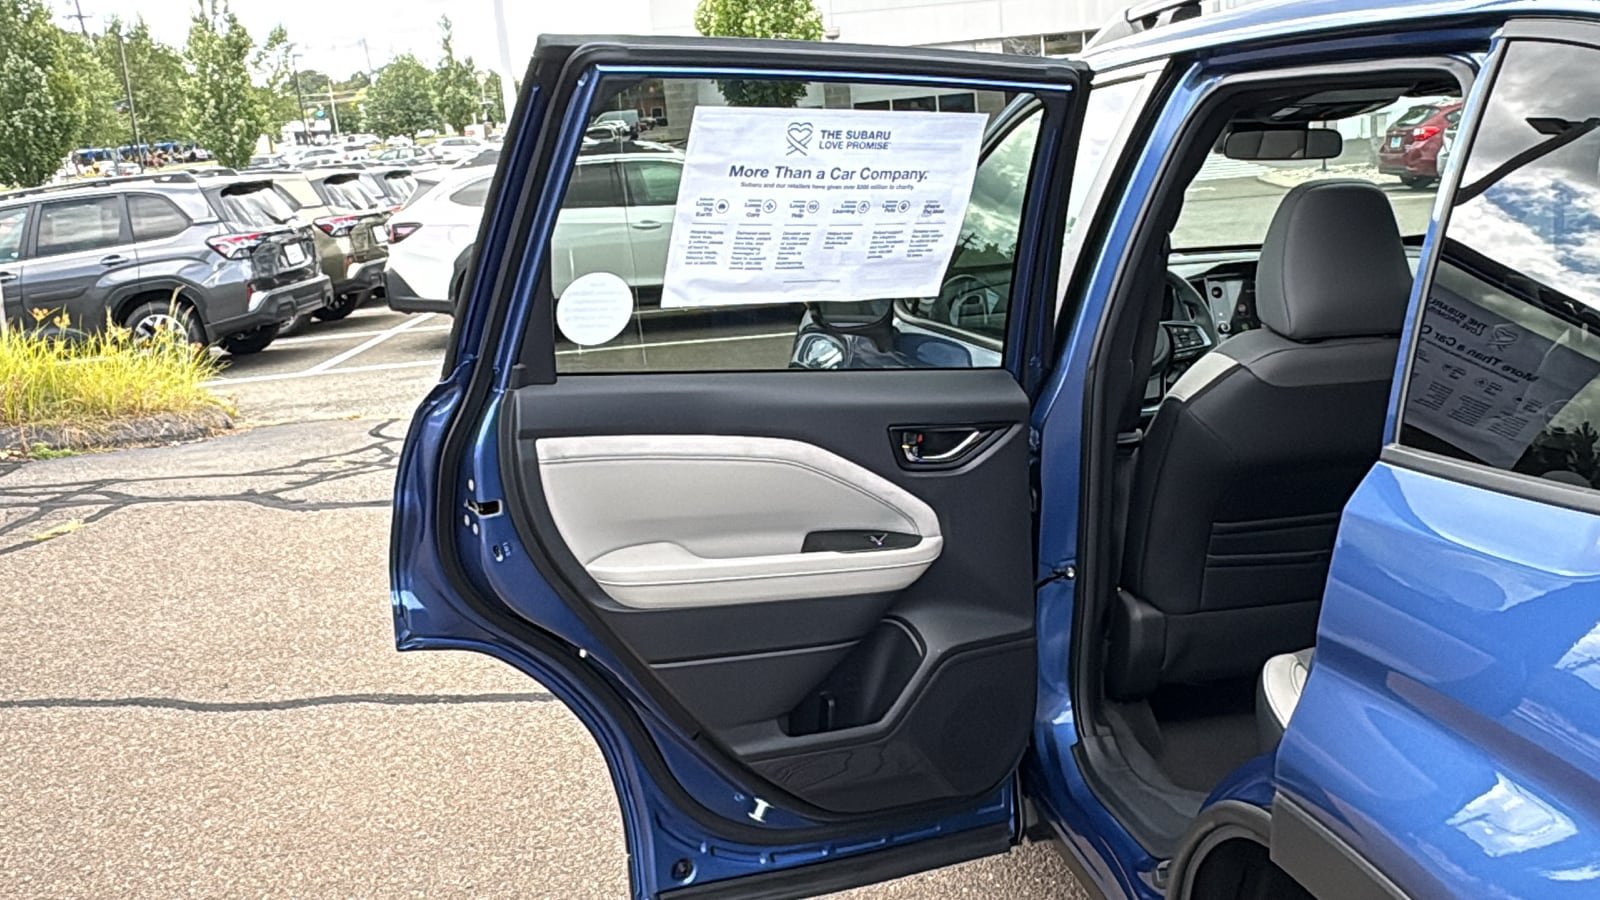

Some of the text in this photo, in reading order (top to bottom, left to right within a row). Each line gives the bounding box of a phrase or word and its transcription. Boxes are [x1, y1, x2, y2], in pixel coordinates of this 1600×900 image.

[820, 129, 892, 140] THE SUBARU
[819, 140, 890, 150] LOVE PROMISE
[728, 164, 928, 183] More Than a Car Company.
